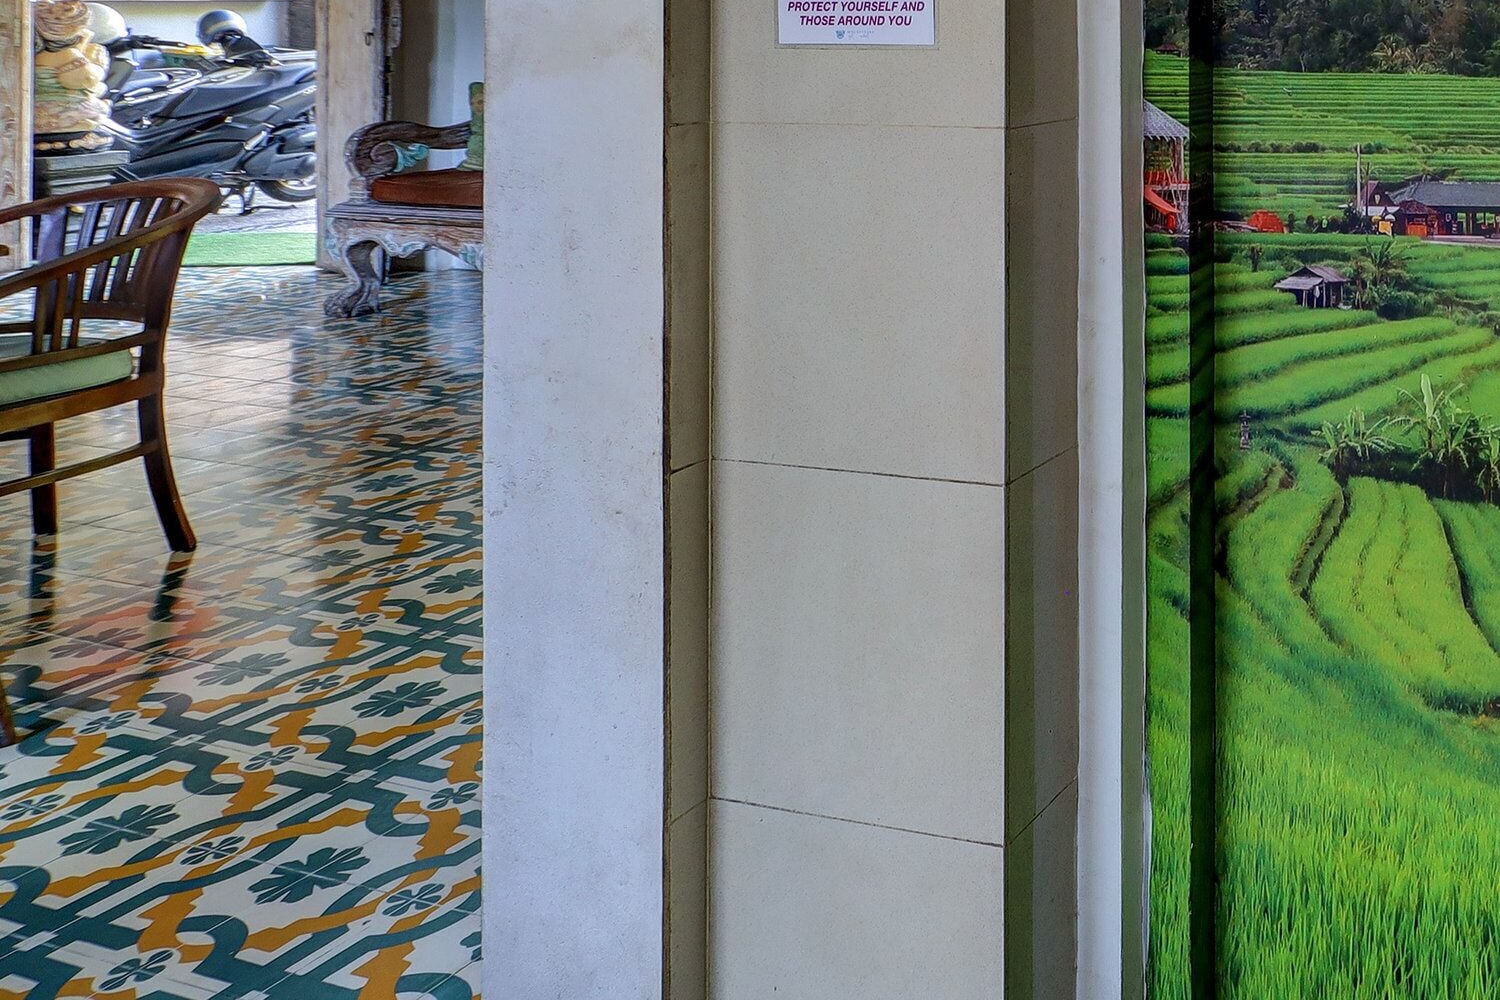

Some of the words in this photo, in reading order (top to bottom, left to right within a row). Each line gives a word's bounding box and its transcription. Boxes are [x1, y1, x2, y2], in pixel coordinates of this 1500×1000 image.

[787, 1, 838, 12] PROTECT
[840, 1, 899, 12] YOURSELF
[900, 1, 925, 12] AND
[800, 15, 836, 26] THOSE
[837, 15, 885, 26] AROUND
[888, 15, 912, 26] YOU
